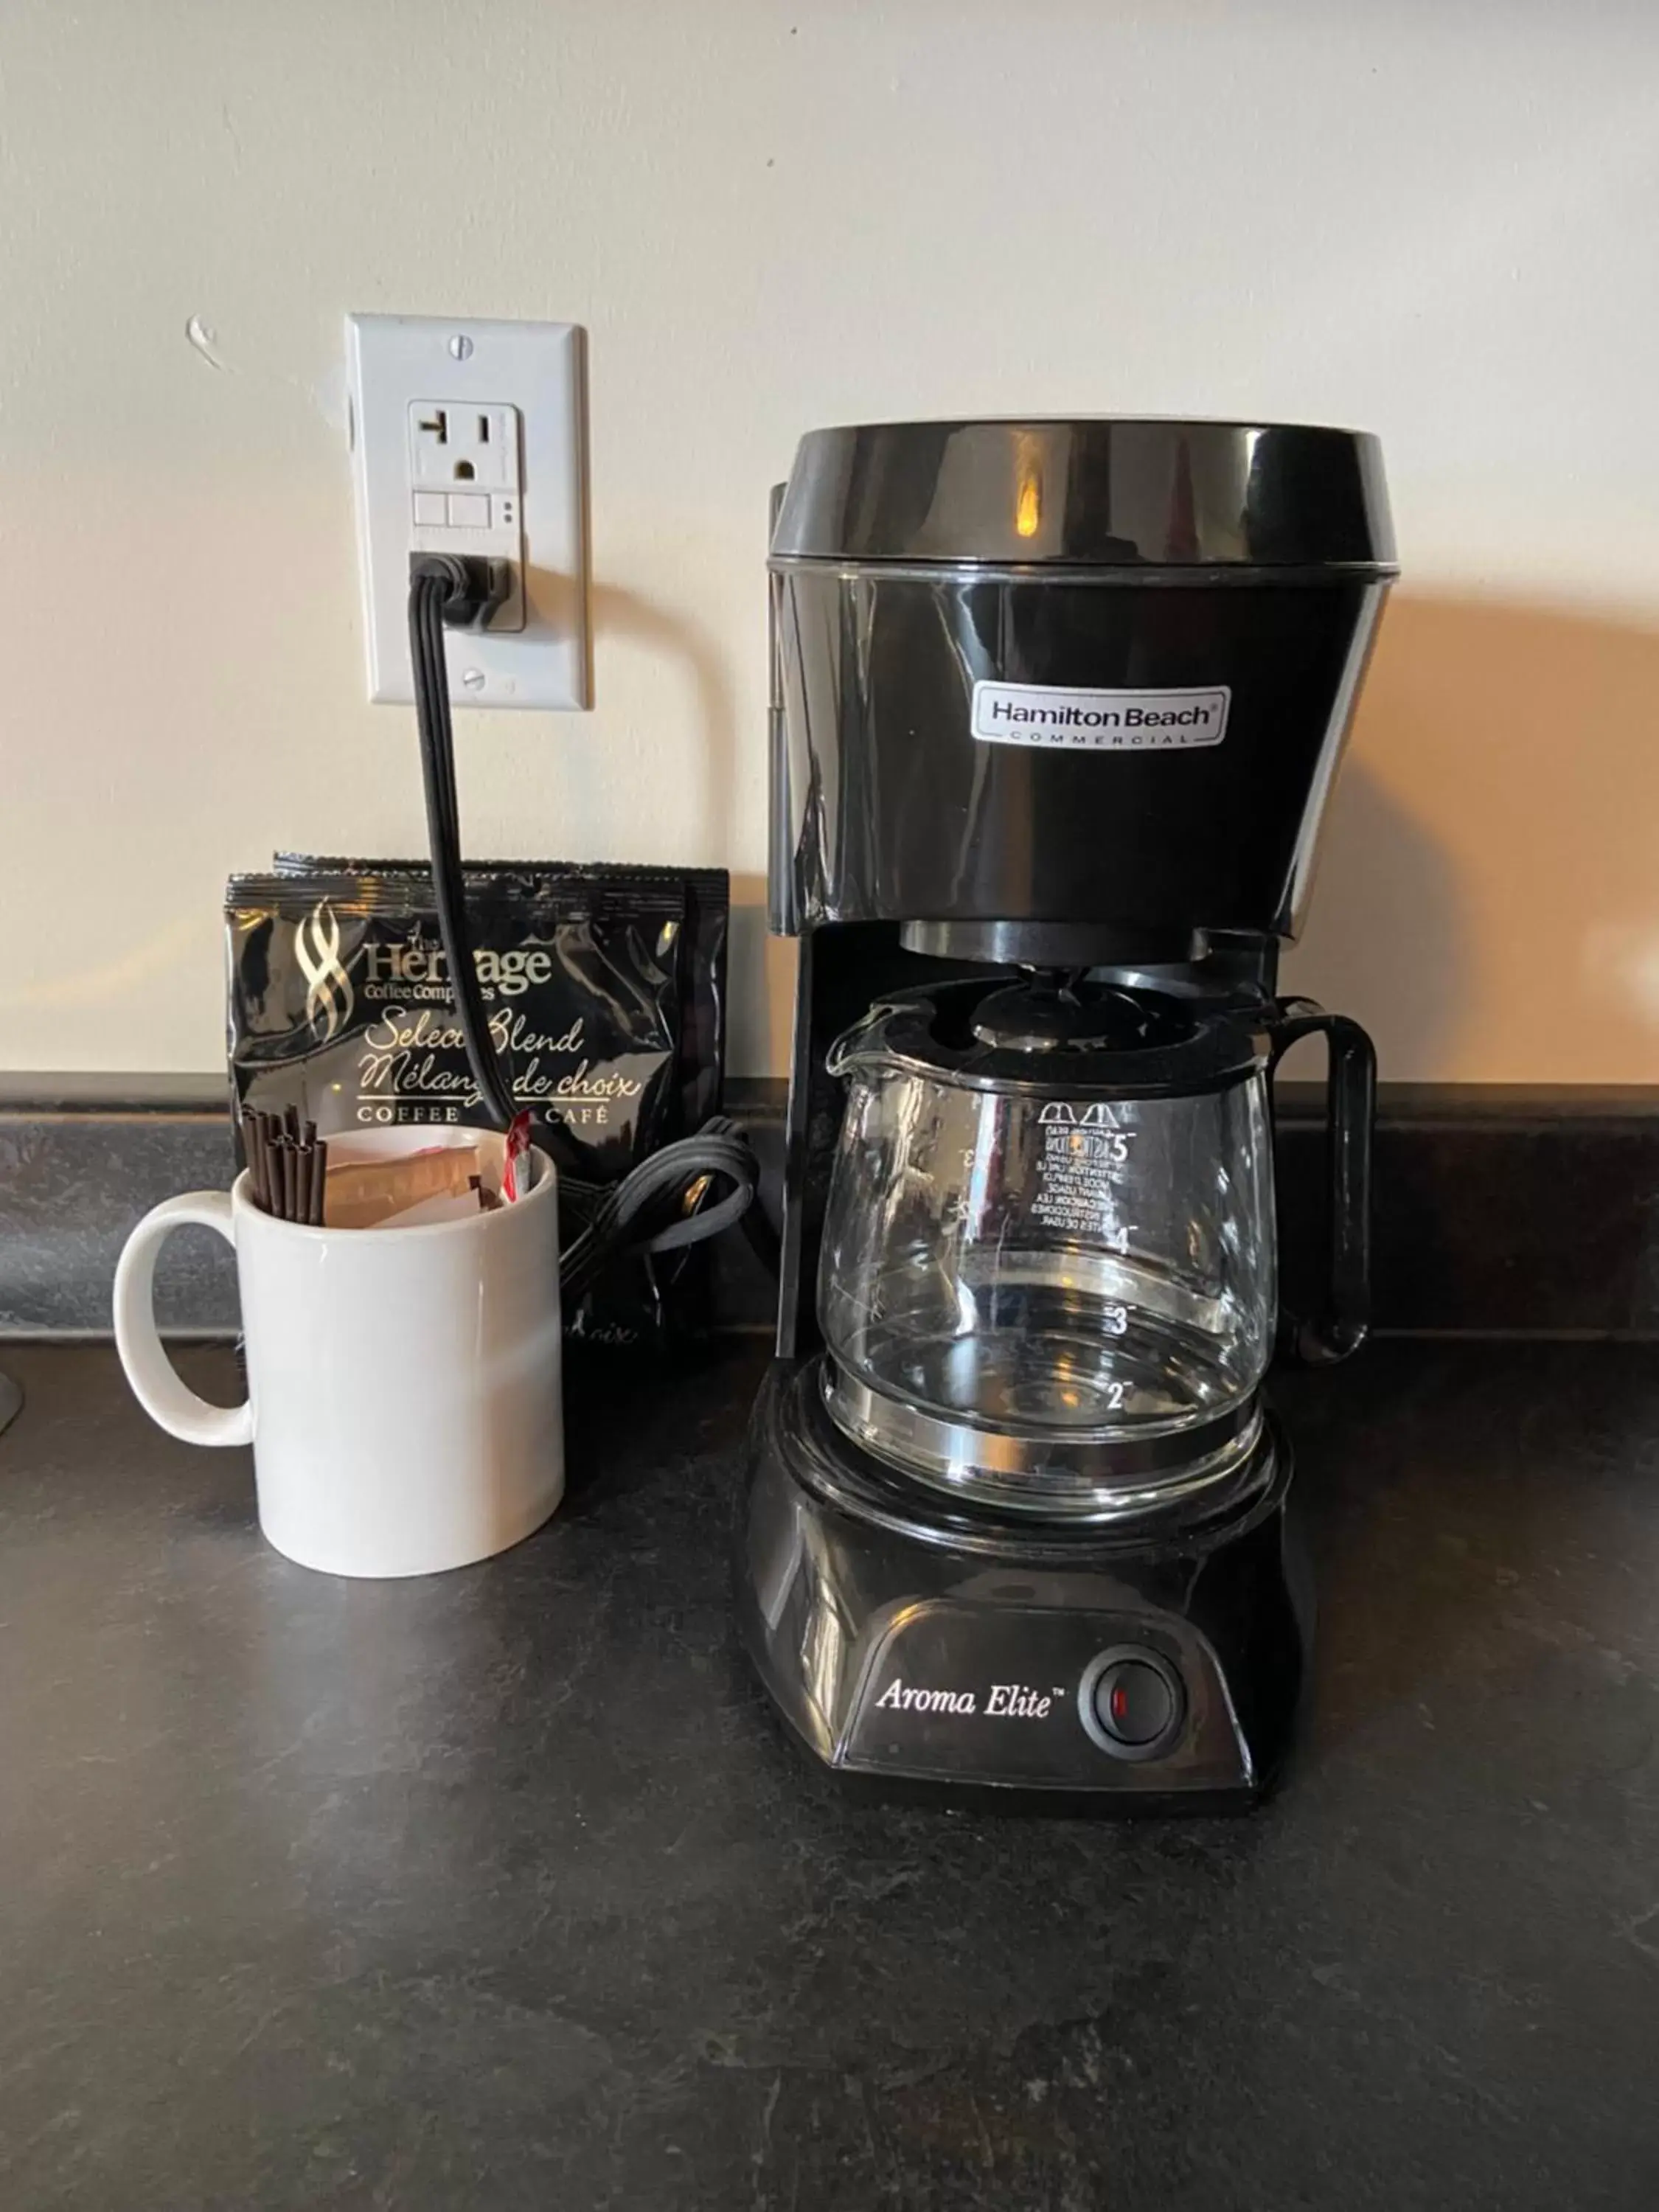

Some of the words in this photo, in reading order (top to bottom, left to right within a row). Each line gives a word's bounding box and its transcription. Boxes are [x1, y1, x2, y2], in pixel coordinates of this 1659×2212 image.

[992, 701, 1120, 727] Hamilton
[1009, 731, 1187, 745] COMMERCIAL
[364, 943, 552, 995] Herage
[488, 1006, 584, 1056] Blend
[358, 1050, 484, 1107] Mélang
[512, 1057, 552, 1094] de
[557, 1059, 643, 1097] choix
[357, 1106, 459, 1122] COFFEE
[544, 1105, 609, 1124] CAFÉ
[1109, 1134, 1129, 1162] 5
[1112, 1307, 1127, 1335] 3
[1107, 1382, 1124, 1410] 2
[875, 1678, 975, 1714] Aroma
